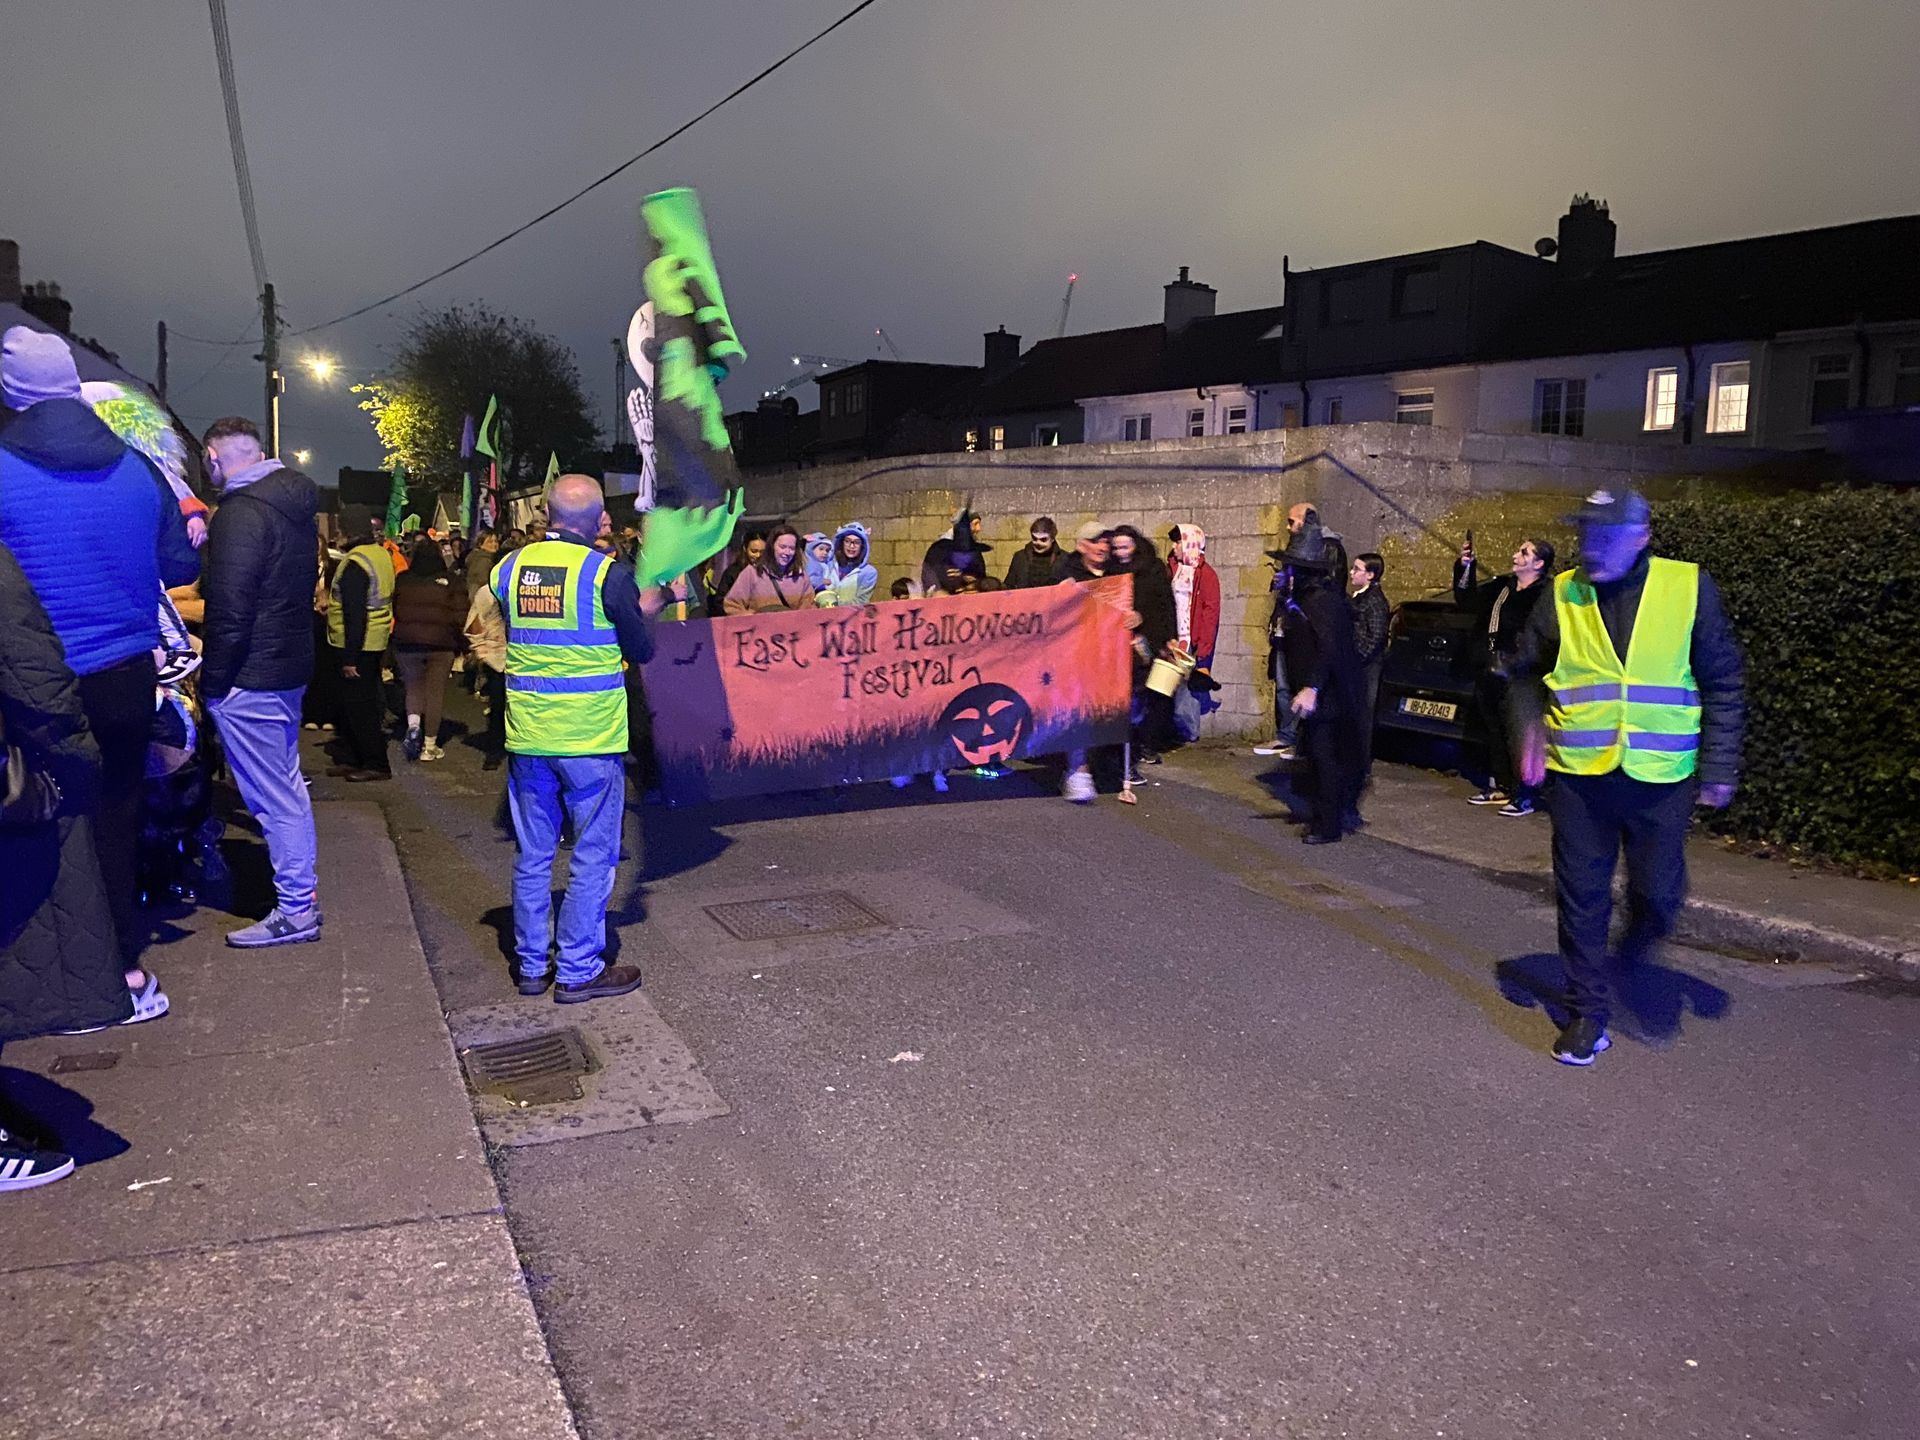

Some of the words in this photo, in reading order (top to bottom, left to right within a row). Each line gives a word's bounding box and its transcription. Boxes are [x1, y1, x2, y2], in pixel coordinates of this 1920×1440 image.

[519, 585, 539, 596] east
[541, 585, 561, 597] wall
[520, 596, 560, 613] youth
[732, 626, 809, 672] East
[819, 606, 878, 658] Wall
[892, 607, 1044, 651] Halloween
[840, 654, 955, 699] Festival
